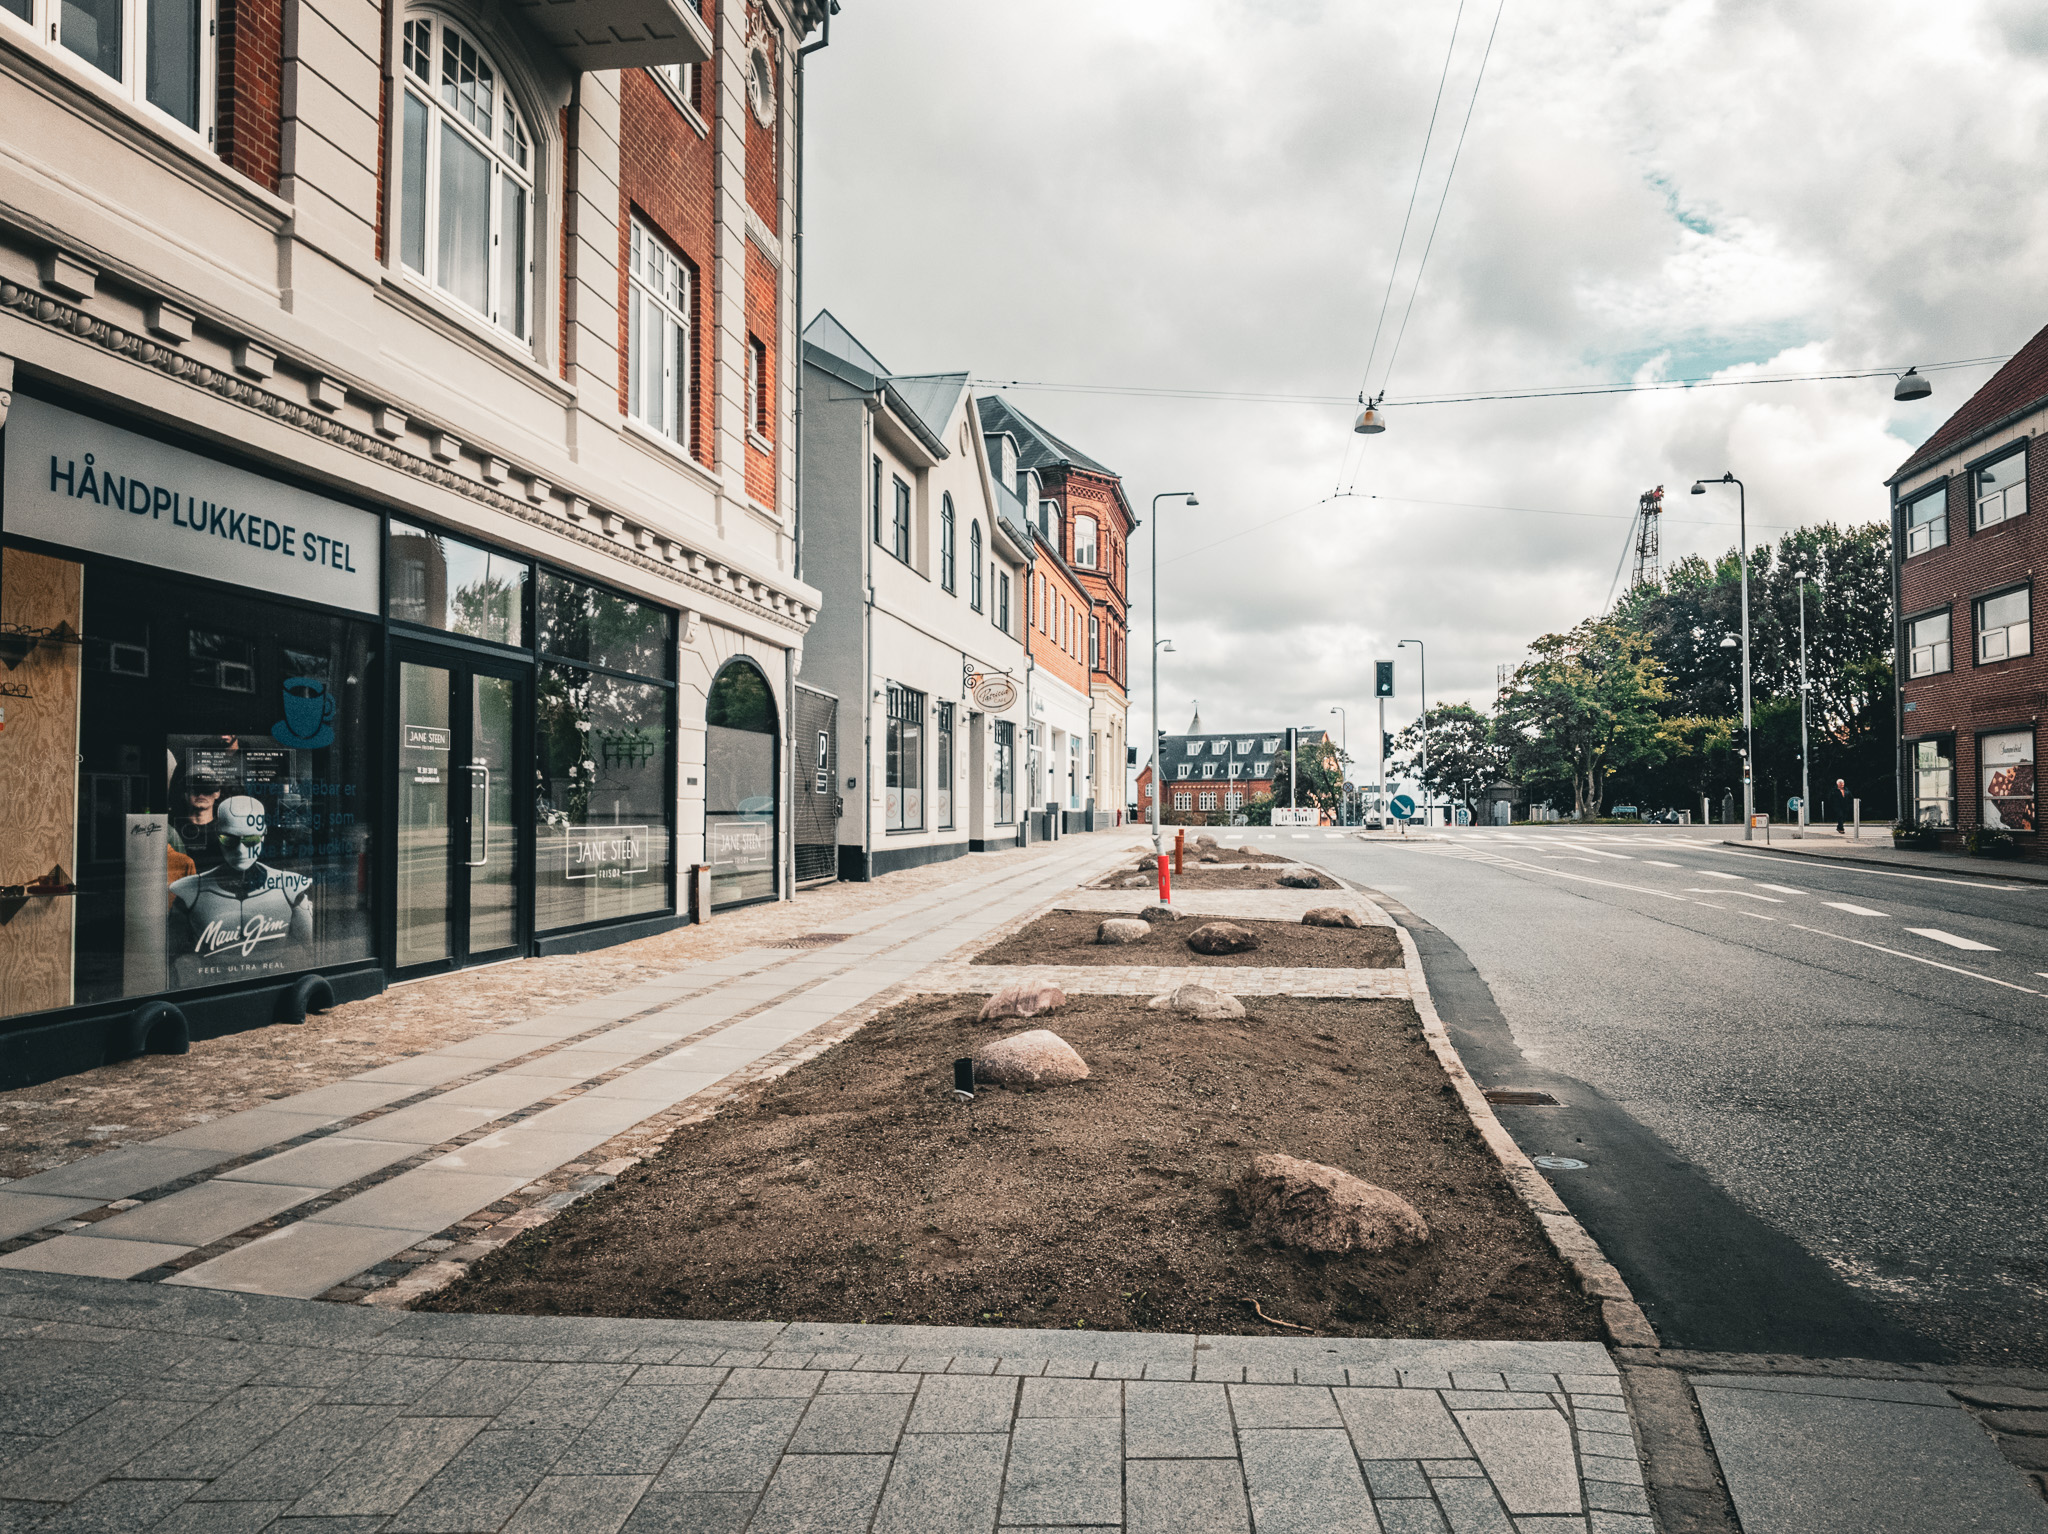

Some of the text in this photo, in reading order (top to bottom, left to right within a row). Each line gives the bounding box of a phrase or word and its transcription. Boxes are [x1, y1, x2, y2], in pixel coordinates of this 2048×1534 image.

[50, 453, 357, 573] HÅNDPLUKKEDE STEL
[409, 731, 446, 744] JANE STEEN
[820, 735, 827, 766] P
[328, 813, 355, 825] som
[576, 839, 640, 864] JANE STEEN
[720, 833, 762, 852] JANE STEEN
[285, 875, 308, 892] nye
[195, 914, 289, 957] Maui Jim
[198, 966, 221, 974] FEEL
[228, 964, 257, 972] ULTRA
